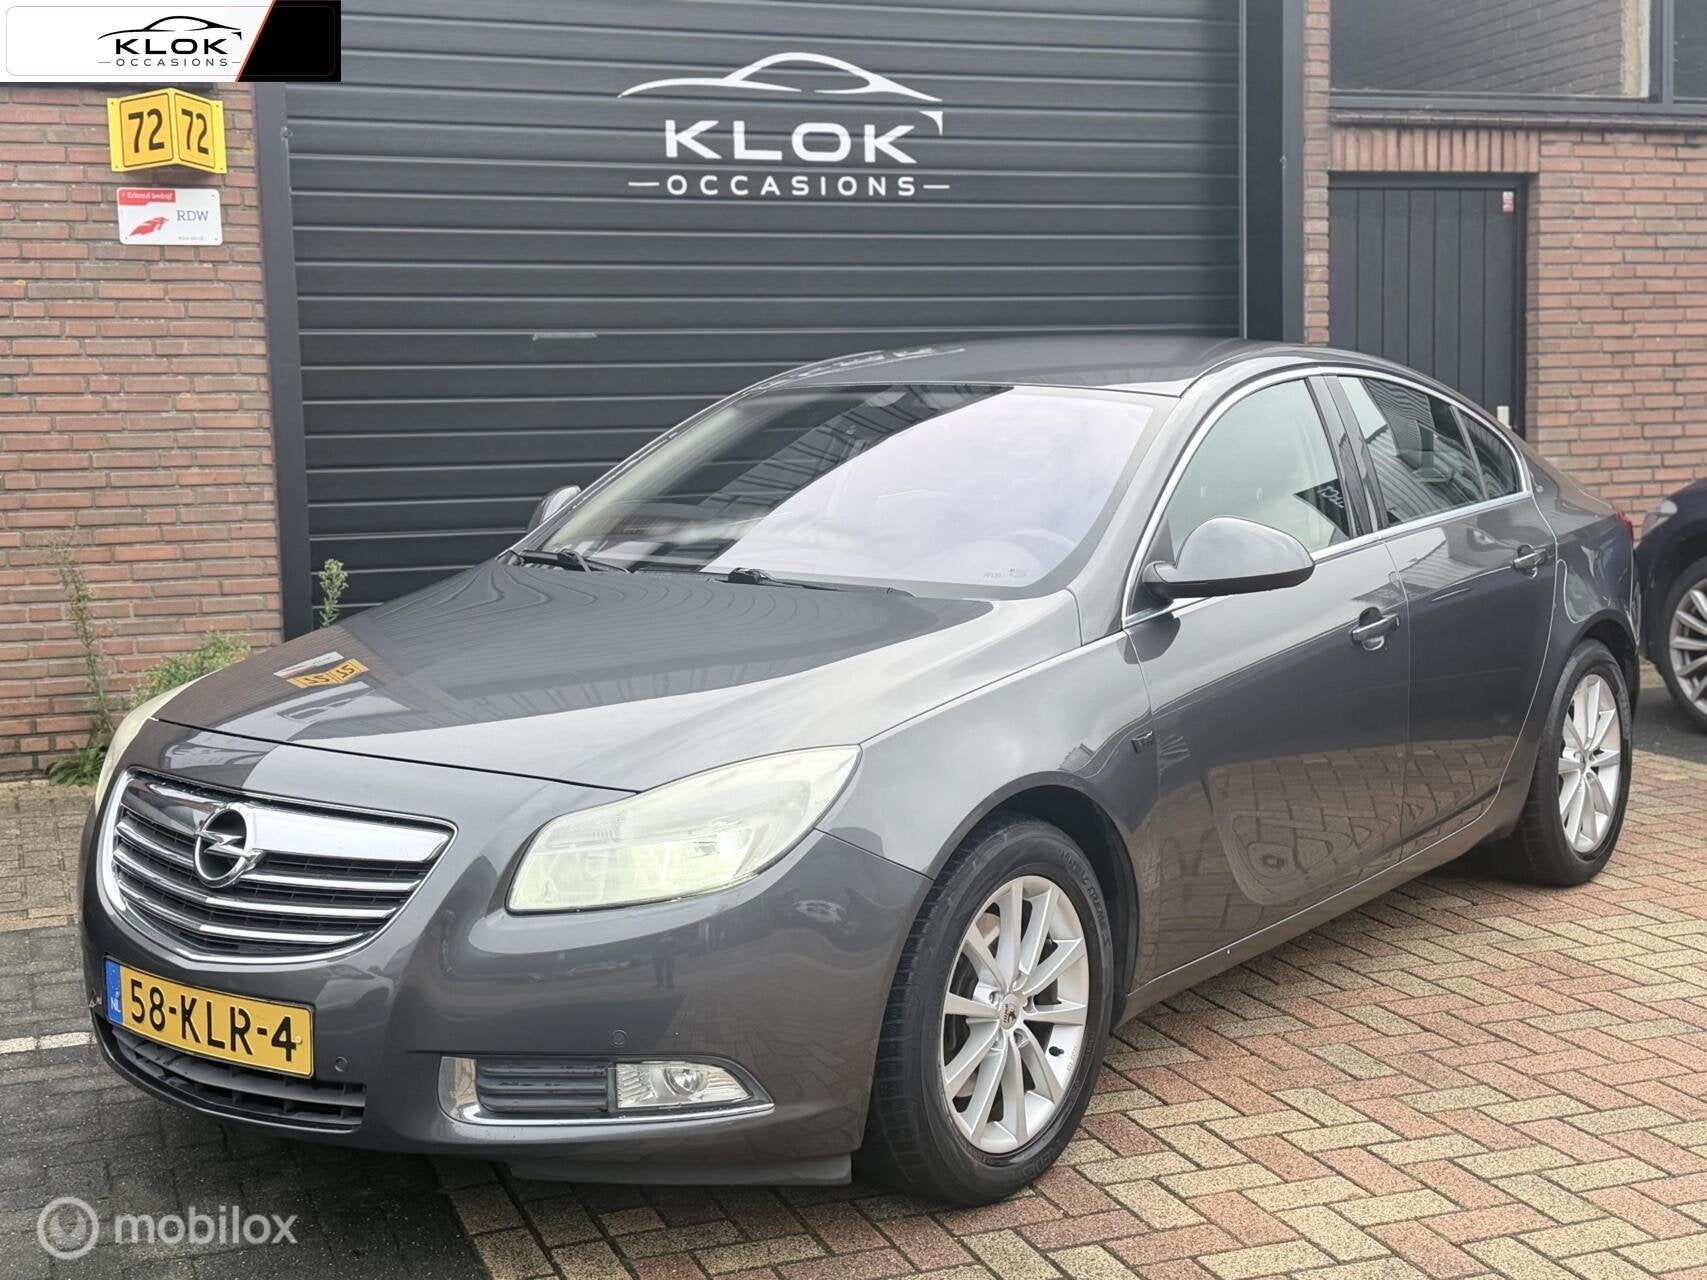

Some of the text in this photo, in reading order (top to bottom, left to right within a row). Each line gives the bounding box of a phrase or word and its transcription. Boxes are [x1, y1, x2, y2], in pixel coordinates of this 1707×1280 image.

[128, 108, 209, 155] 72 72
[665, 119, 918, 164] KLOK
[667, 175, 916, 196] OCCASIONS
[177, 210, 208, 221] RDW
[130, 977, 297, 1062] 58-KLR-4
